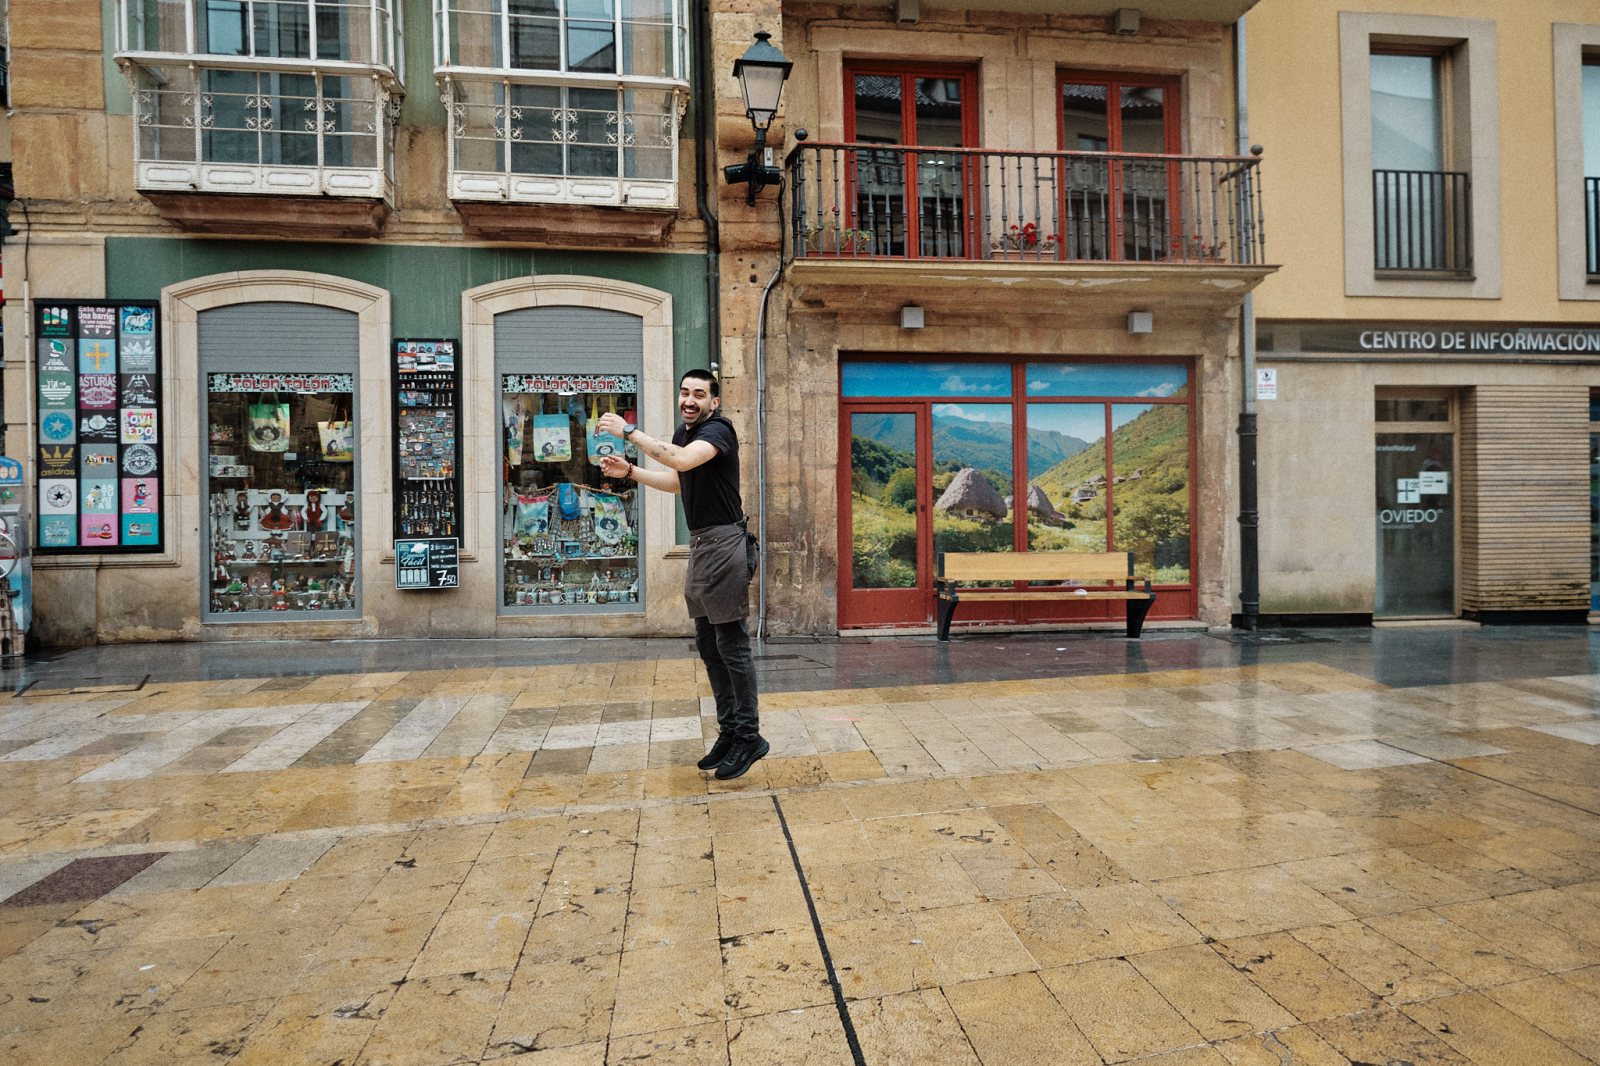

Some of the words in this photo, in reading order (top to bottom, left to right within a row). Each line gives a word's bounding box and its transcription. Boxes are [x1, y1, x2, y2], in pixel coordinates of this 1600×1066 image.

[1360, 331, 1436, 349] CENTRO
[1441, 332, 1465, 349] DE
[1471, 331, 1600, 351] INFORMACIÓN
[79, 376, 116, 387] ASTURIAS
[130, 415, 151, 424] OVI
[128, 426, 153, 436] EDO
[1380, 509, 1437, 523] OVIEDO
